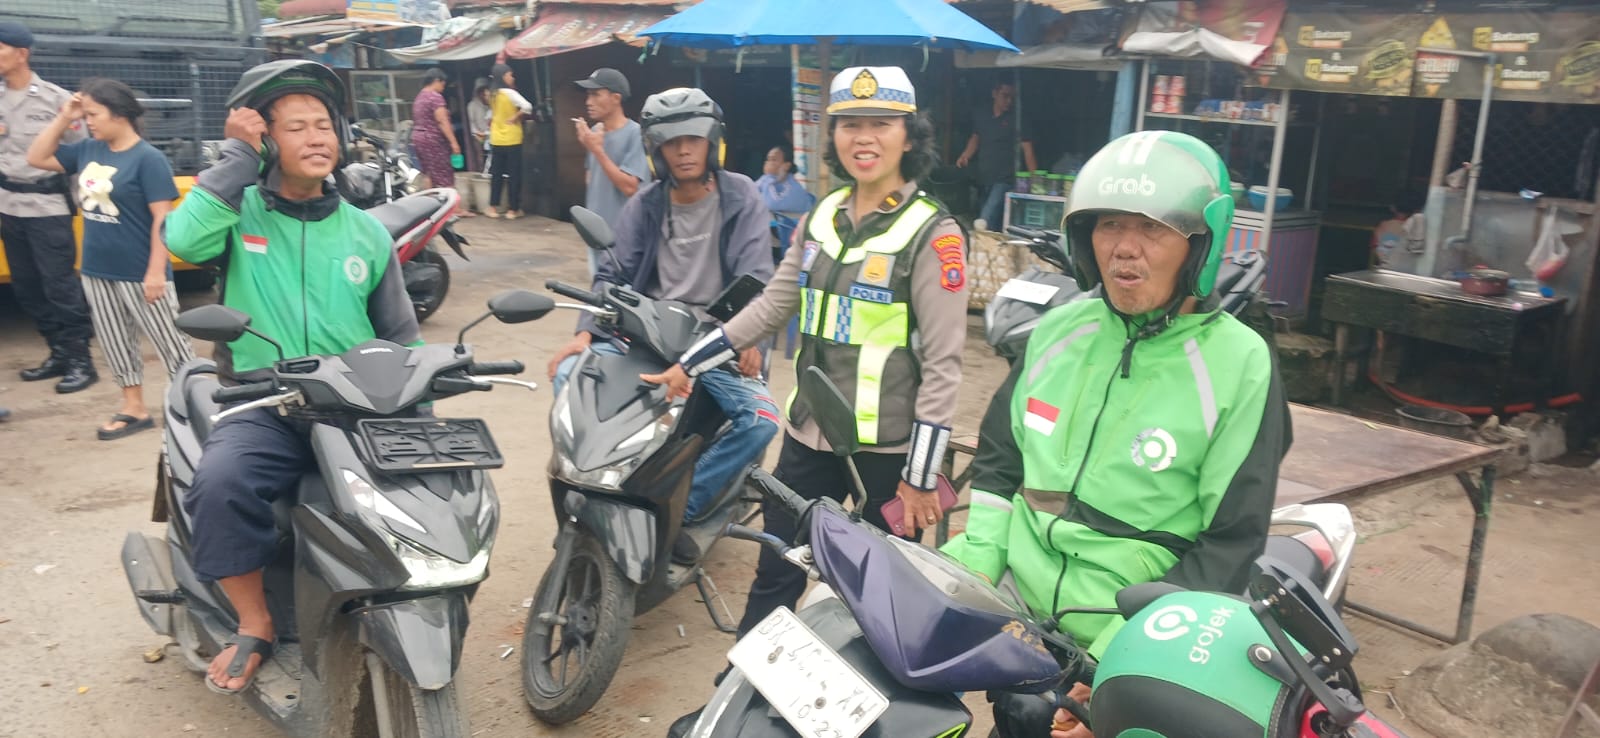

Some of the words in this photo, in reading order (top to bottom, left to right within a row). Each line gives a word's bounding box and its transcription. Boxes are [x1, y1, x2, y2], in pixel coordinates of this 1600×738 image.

[1098, 173, 1157, 197] Grab
[852, 287, 889, 303] POLRI
[1188, 605, 1235, 665] gojek
